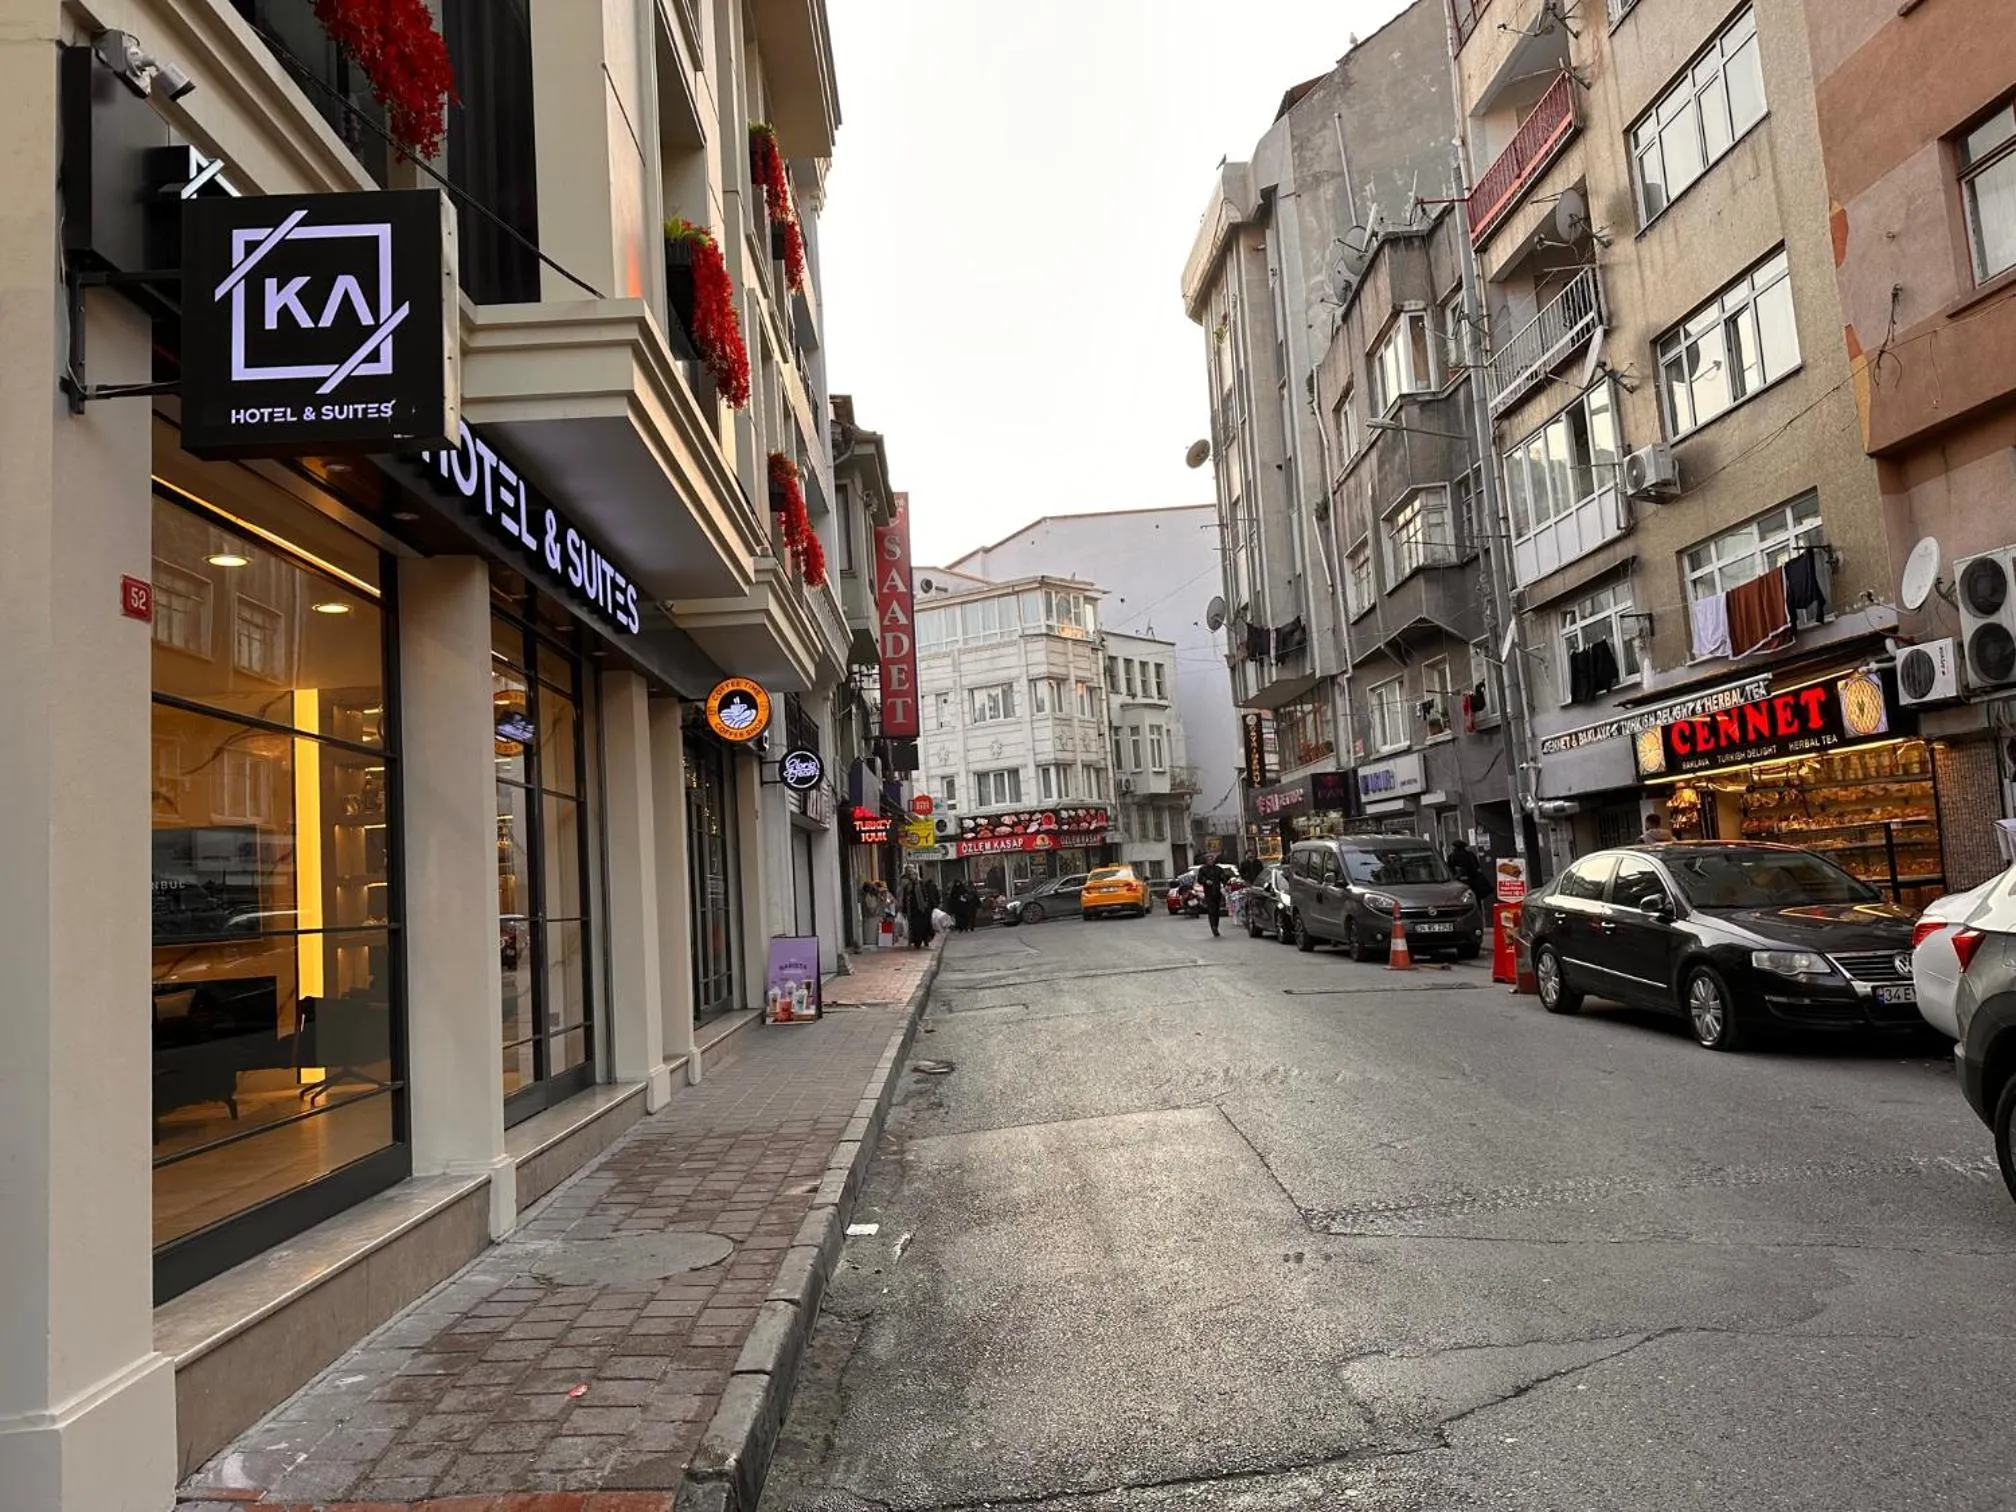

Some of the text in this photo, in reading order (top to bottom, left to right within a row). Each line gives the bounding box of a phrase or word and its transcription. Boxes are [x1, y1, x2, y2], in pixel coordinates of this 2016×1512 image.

[230, 402, 394, 424] HOTEL & SUITES
[544, 508, 562, 574] &
[566, 527, 639, 635] SUITES
[131, 587, 147, 610] 52
[881, 534, 912, 724] SAADET
[712, 679, 762, 701] COFFEE TIME
[1703, 687, 1744, 713] HERBAL
[1744, 680, 1768, 701] TEA
[1671, 687, 1826, 756] CENNET
[1681, 733, 1839, 770] BAKLAVA TURKISH DELIGHT HERBAL TEA
[992, 838, 1024, 849] KASAP
[1885, 988, 1904, 1002] 34
